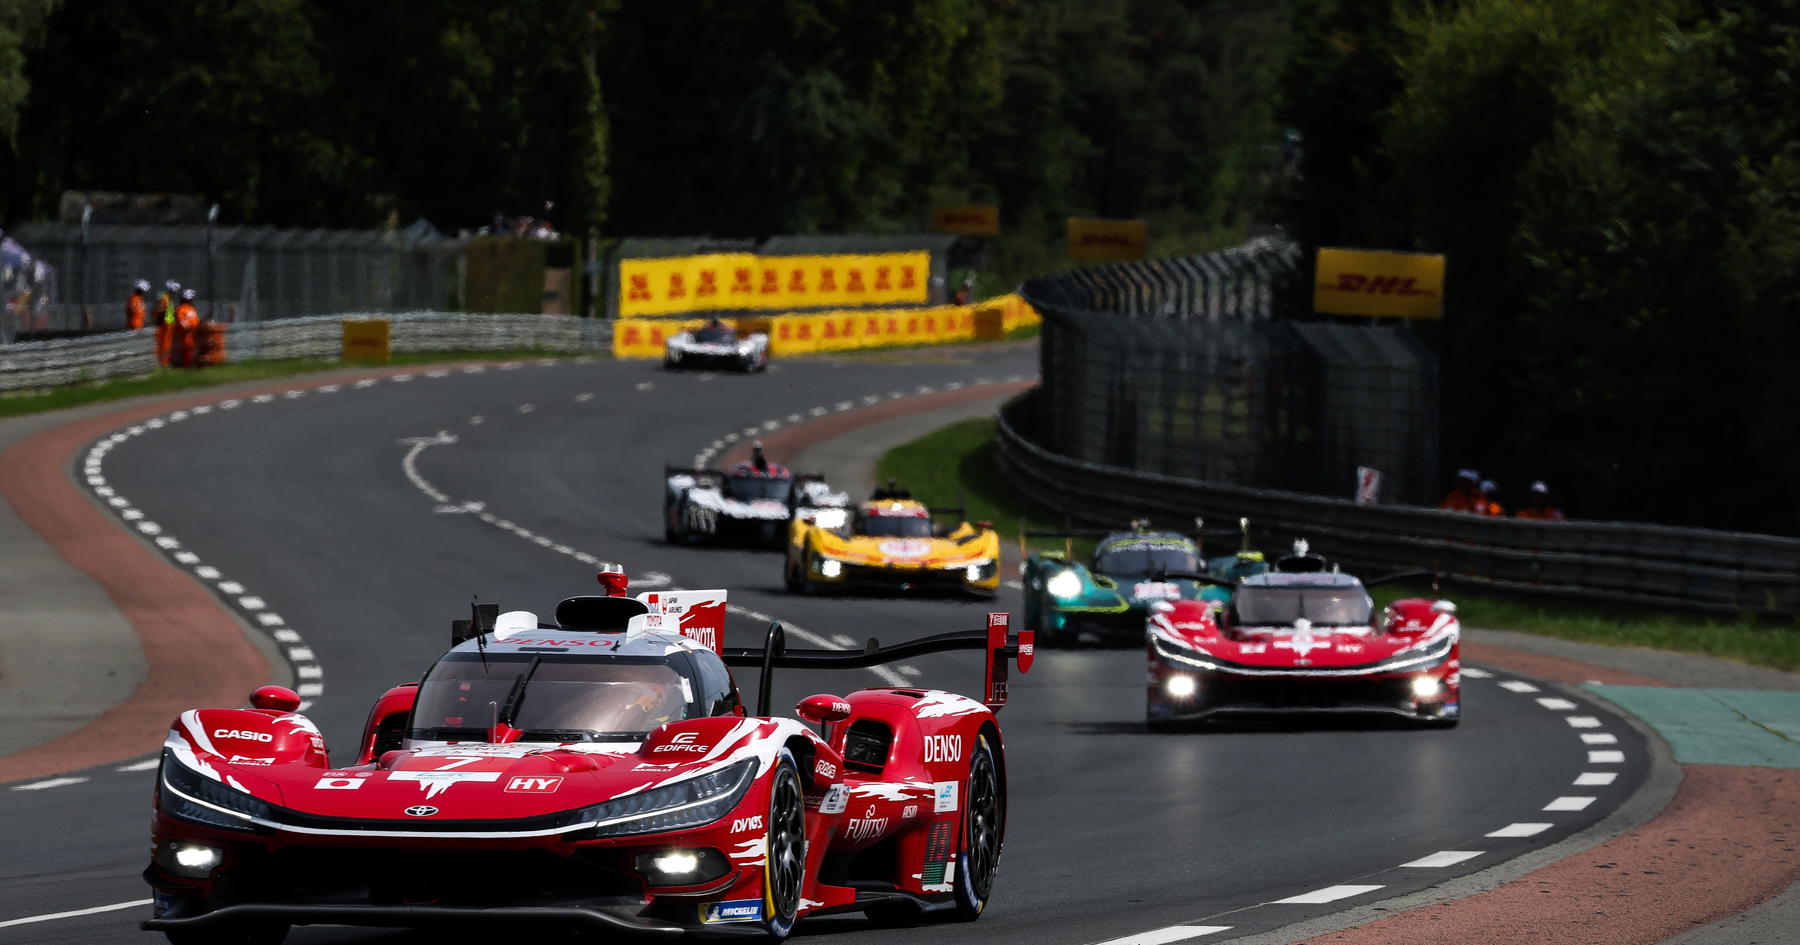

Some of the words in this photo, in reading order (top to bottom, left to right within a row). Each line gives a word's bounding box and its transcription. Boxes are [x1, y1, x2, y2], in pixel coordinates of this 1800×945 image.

[1337, 274, 1421, 296] DHL
[495, 637, 612, 647] DENSO
[685, 627, 716, 651] TOYOTA
[214, 729, 273, 742] CASIO
[653, 744, 709, 752] EDIFICE
[924, 735, 962, 763] DENSO
[433, 756, 484, 771] 7
[509, 778, 558, 790] HY
[730, 815, 763, 834] ADVICS
[844, 817, 889, 844] FUJITSU
[721, 906, 759, 917] MICHELIN
